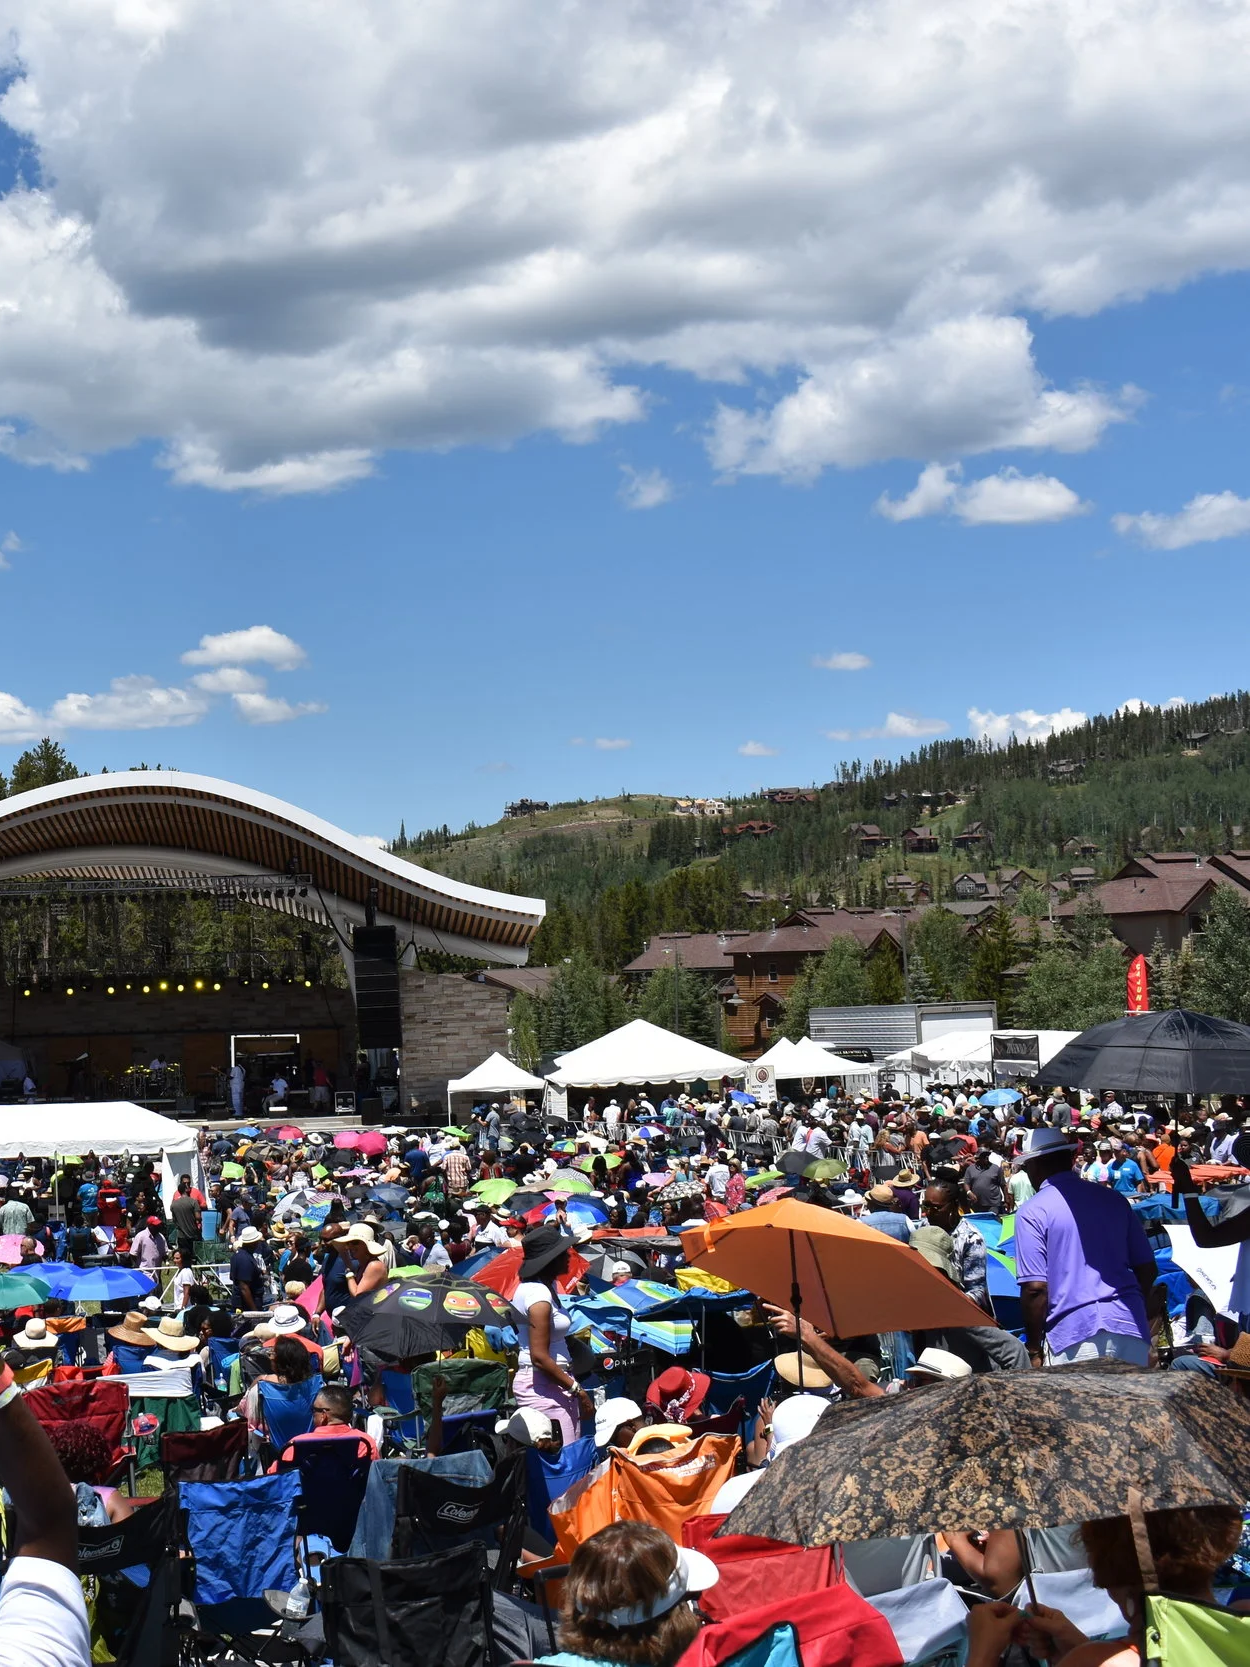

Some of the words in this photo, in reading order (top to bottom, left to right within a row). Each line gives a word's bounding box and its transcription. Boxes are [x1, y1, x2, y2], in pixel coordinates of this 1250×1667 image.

[1135, 963, 1143, 1001] CAJUN
[1123, 1092, 1137, 1103] Ice
[1138, 1092, 1164, 1103] Cream
